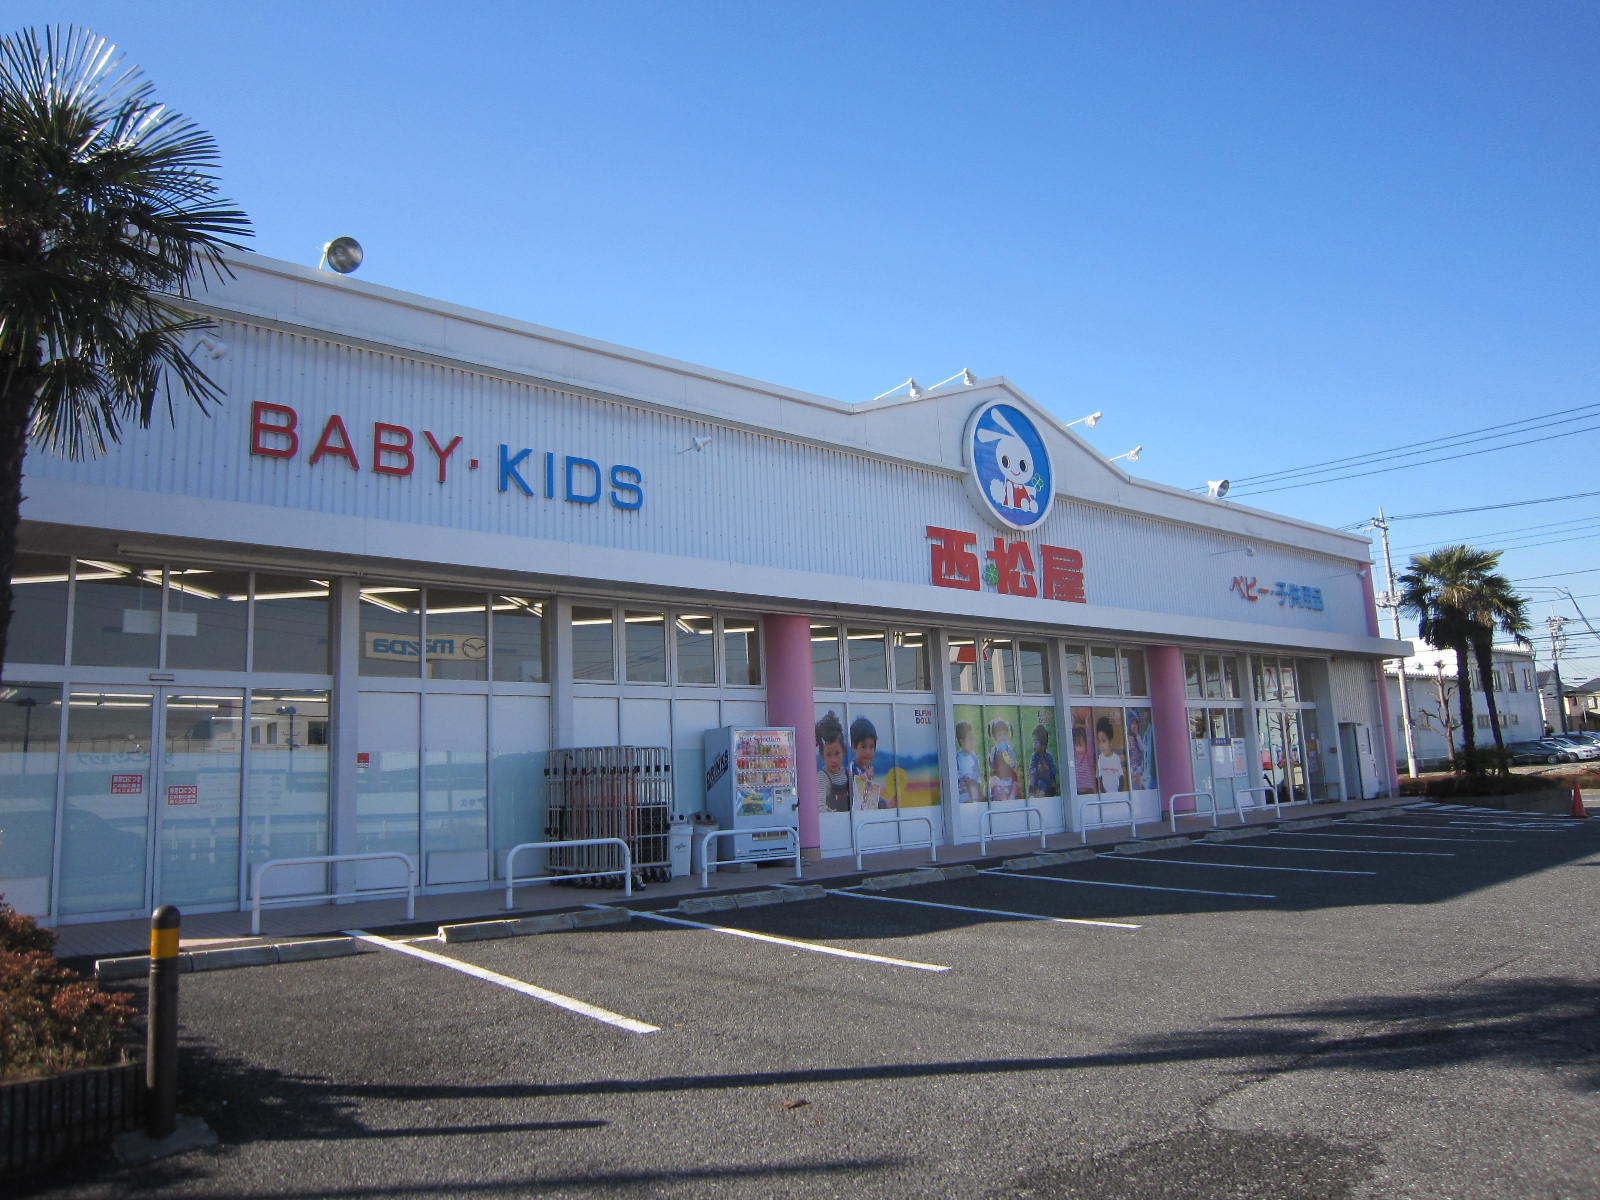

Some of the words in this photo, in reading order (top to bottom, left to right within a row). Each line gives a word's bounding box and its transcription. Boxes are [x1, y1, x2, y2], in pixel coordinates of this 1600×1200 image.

[497, 443, 643, 510] KIDS
[926, 525, 1087, 604] 西松屋
